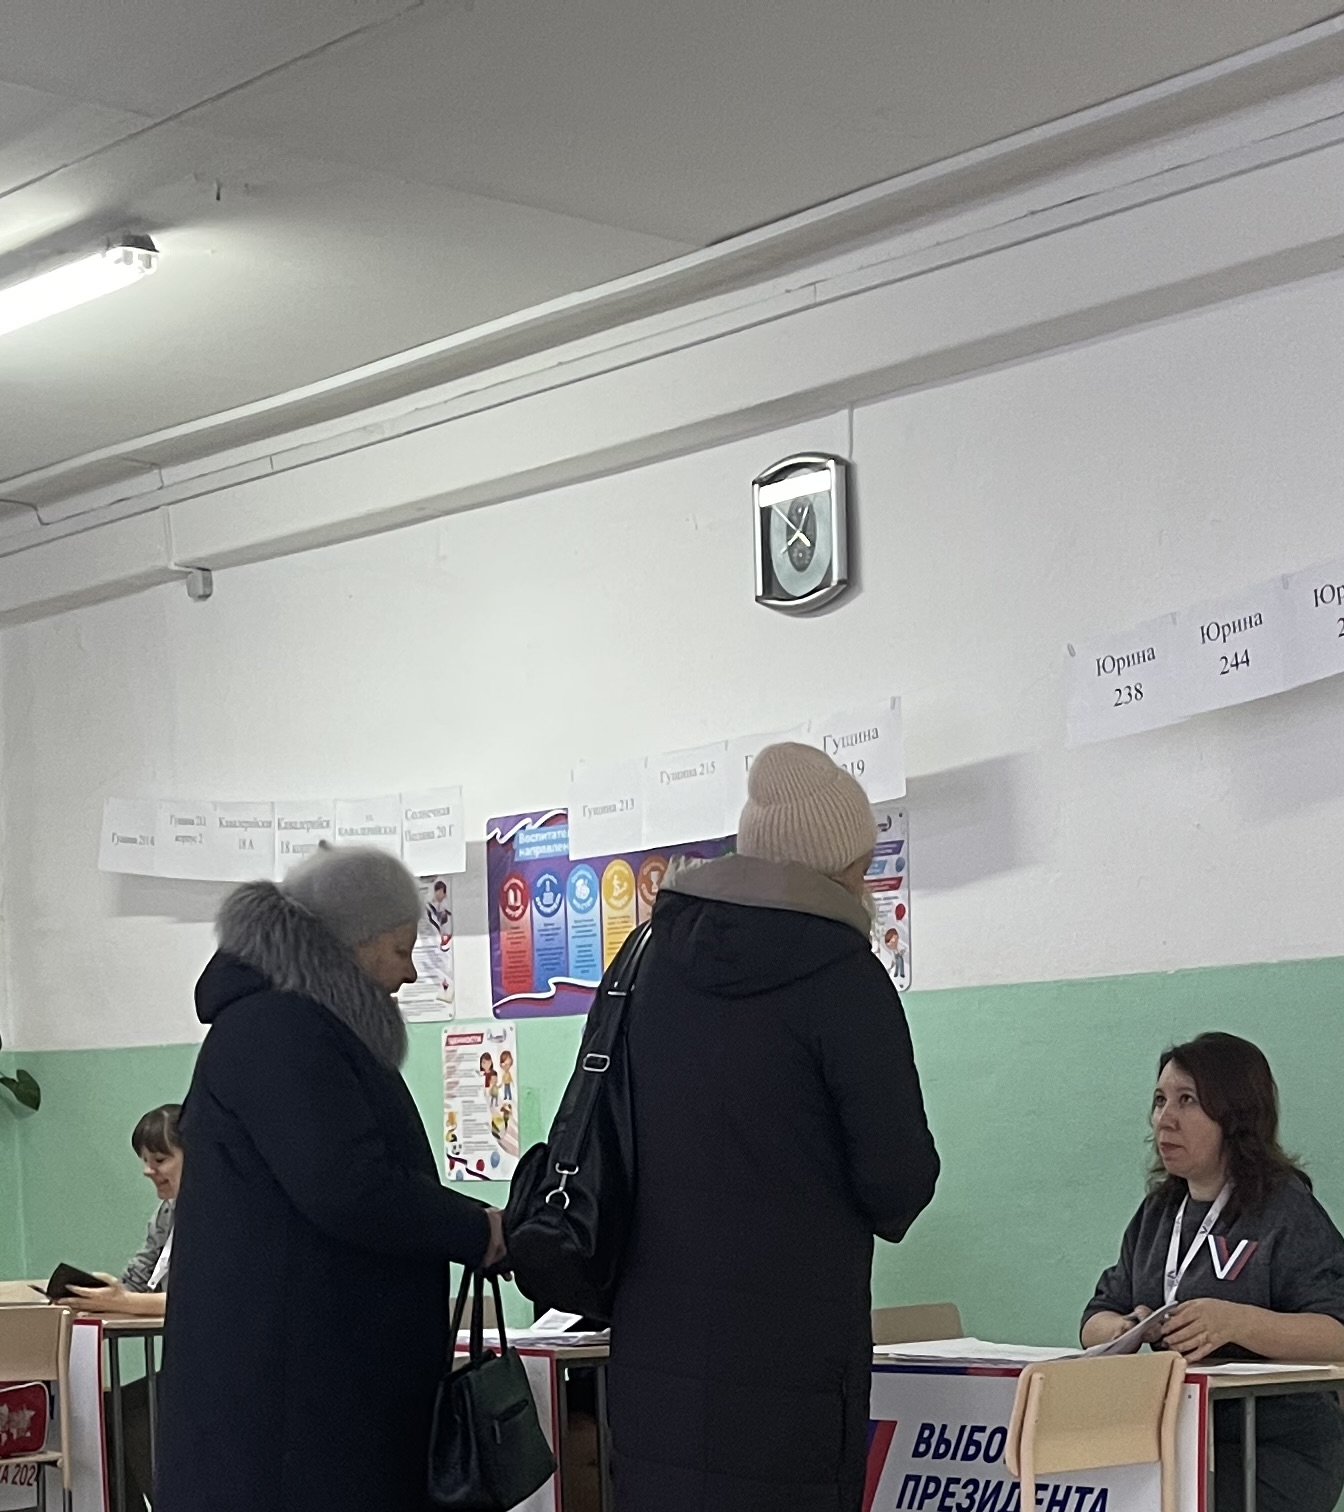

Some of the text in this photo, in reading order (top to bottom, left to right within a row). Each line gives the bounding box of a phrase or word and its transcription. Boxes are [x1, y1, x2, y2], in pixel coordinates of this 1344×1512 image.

[1200, 611, 1263, 644] Юрина
[1096, 645, 1156, 677] Юрина
[1218, 648, 1250, 675] 244
[1113, 682, 1144, 707] 238
[823, 727, 879, 755] Гущина
[699, 760, 716, 775] 215
[619, 798, 635, 811] 213
[911, 1422, 1007, 1464] ВЫБО
[12, 1463, 38, 1486] 202
